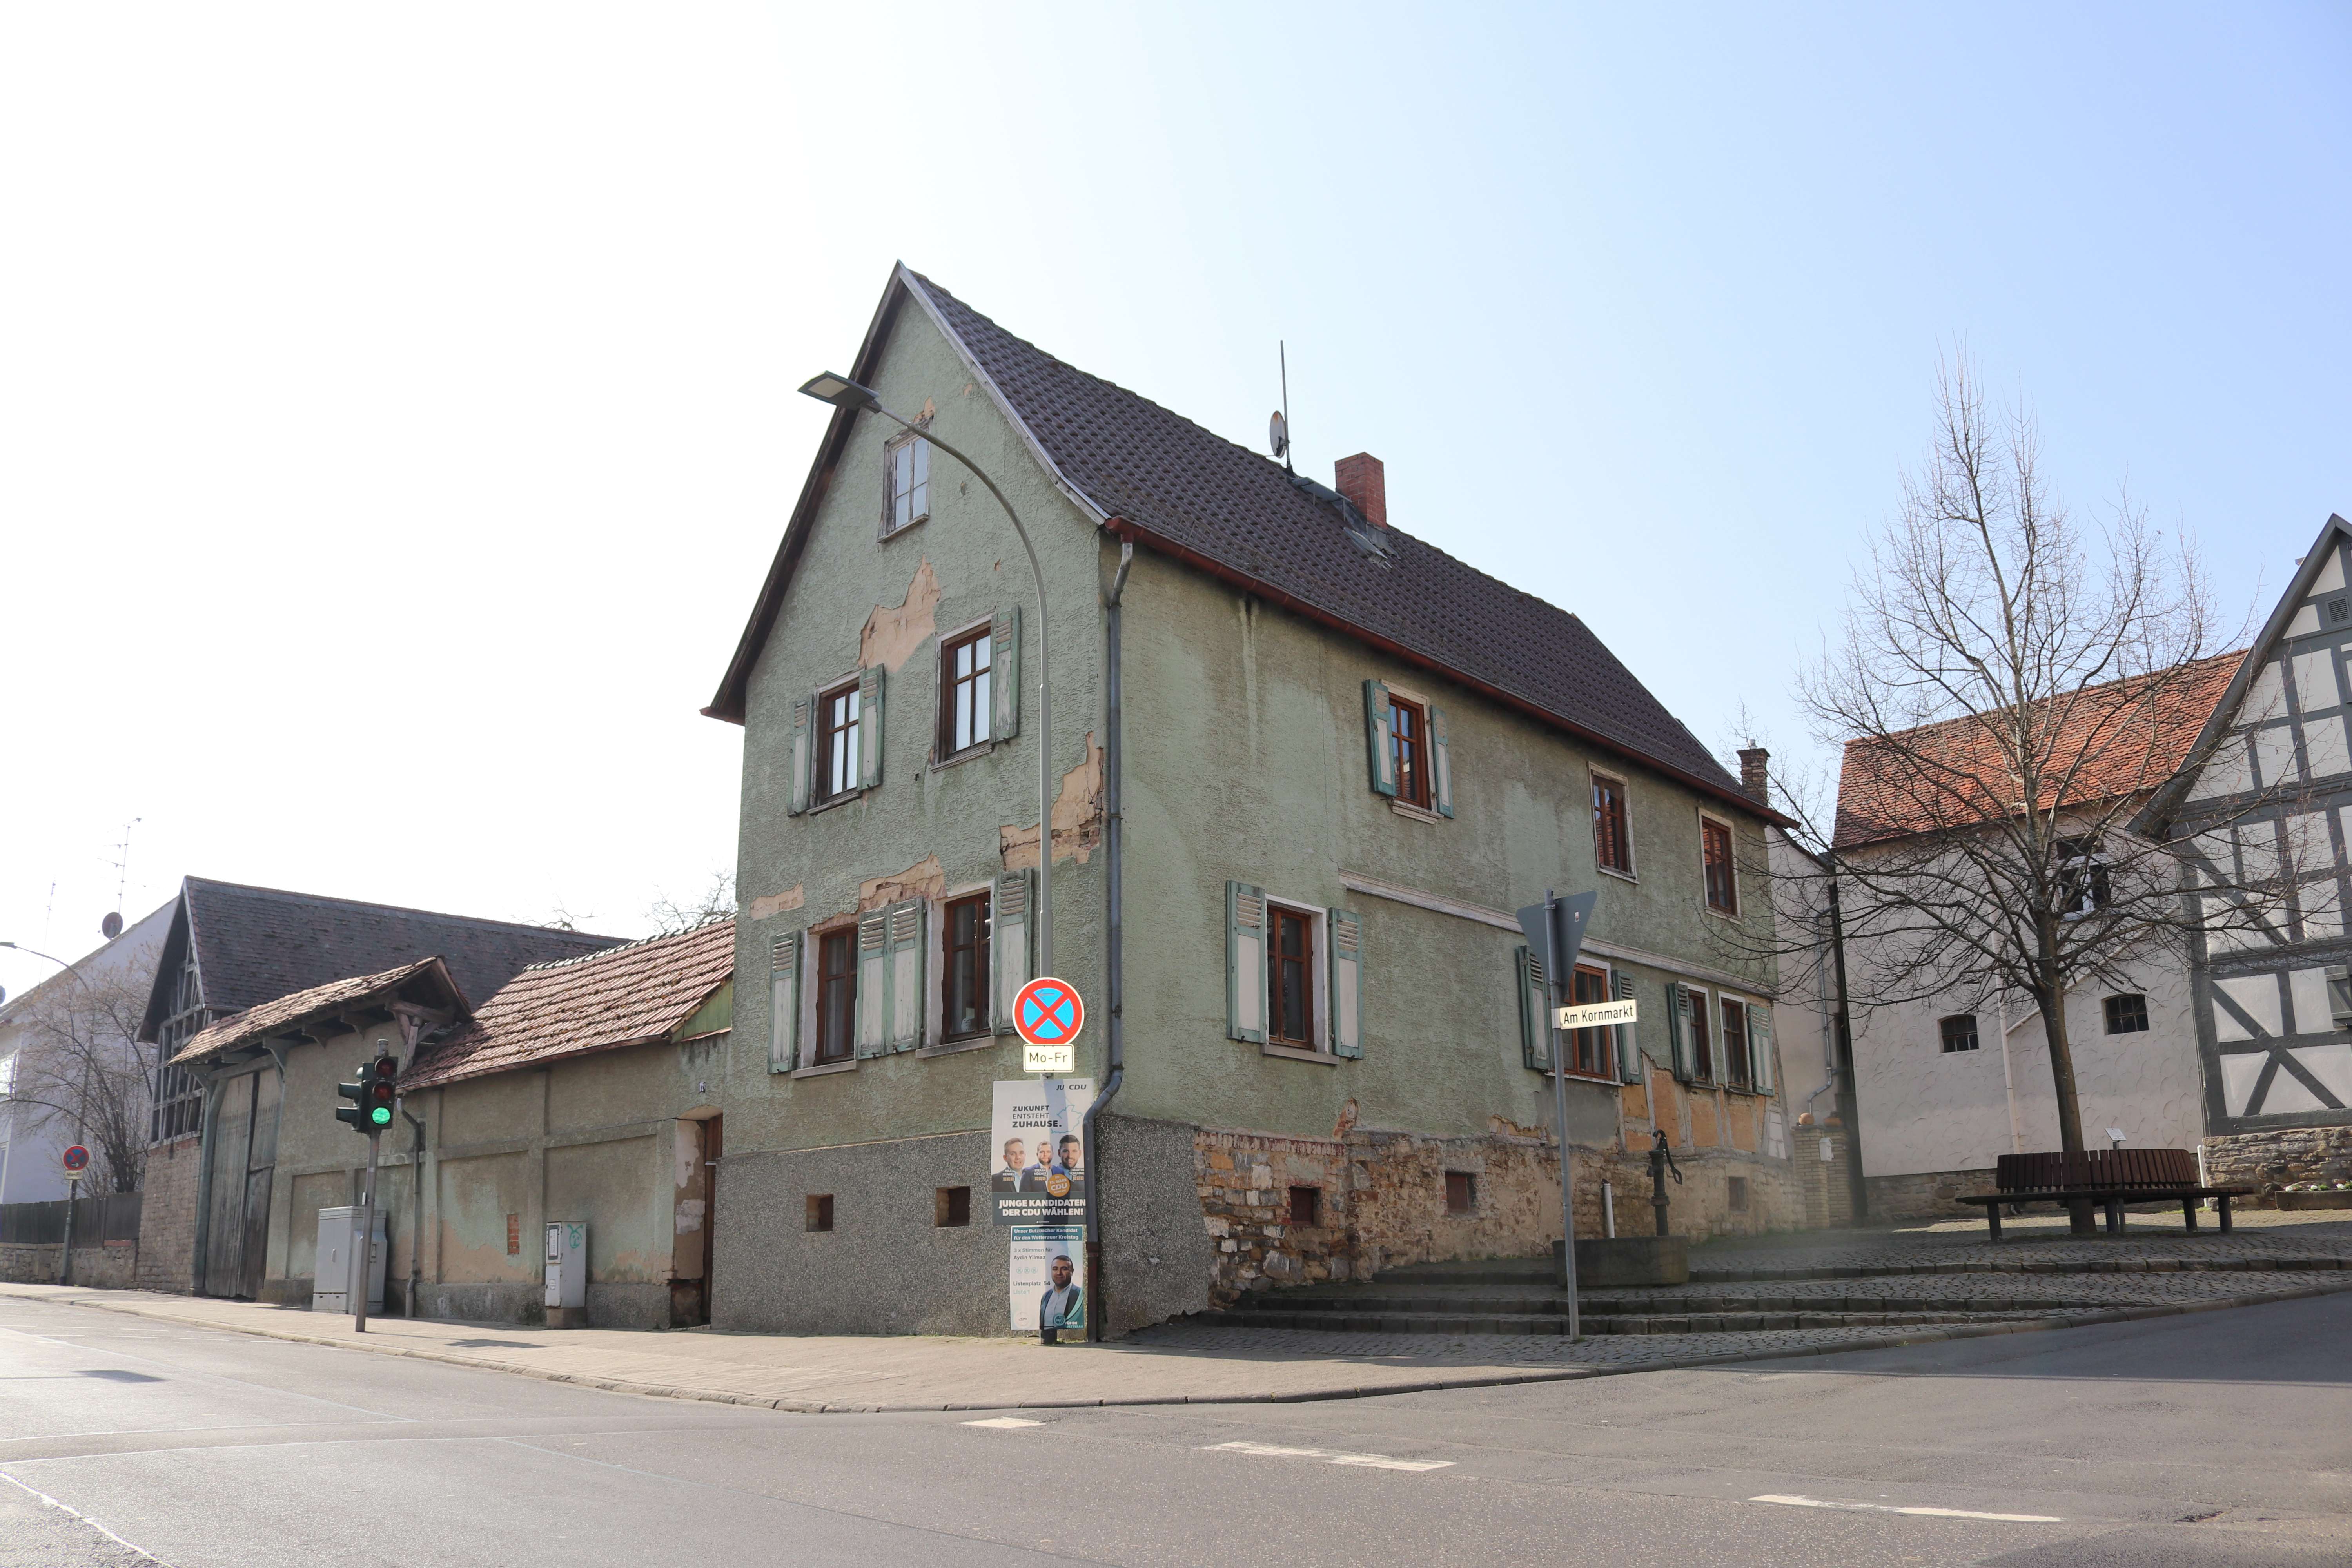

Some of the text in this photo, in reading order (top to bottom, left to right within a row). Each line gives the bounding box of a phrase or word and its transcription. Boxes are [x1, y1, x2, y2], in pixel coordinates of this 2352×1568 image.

[1564, 1005, 1633, 1024] Am Kornmarkt
[1029, 1052, 1067, 1063] Mo-Fr
[999, 1200, 1027, 1209] JUNGE
[1042, 1207, 1083, 1216] WÄHLEN!
